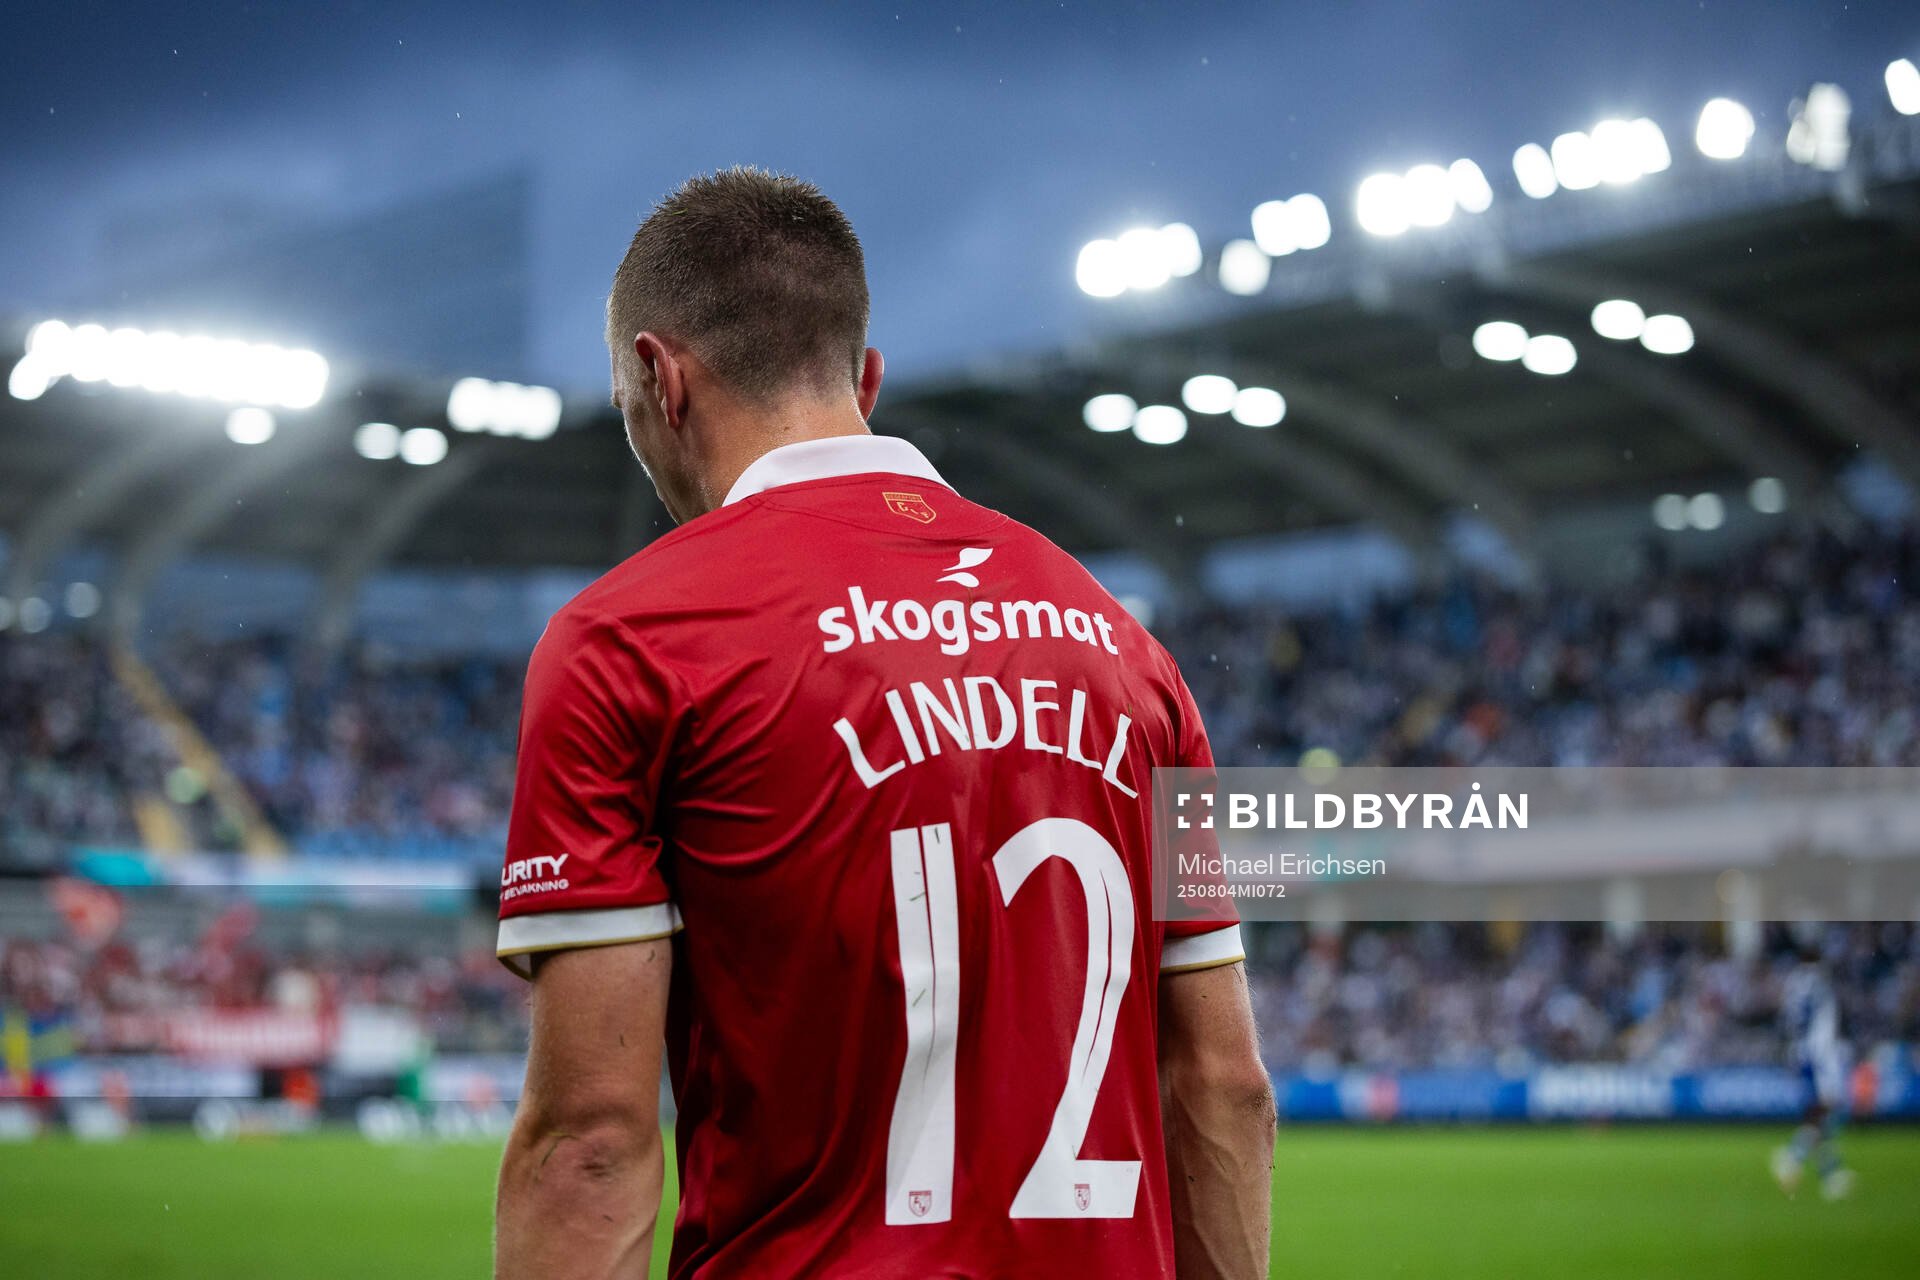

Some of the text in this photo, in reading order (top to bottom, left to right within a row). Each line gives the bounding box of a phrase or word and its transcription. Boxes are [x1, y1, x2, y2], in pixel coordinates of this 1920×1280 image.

[818, 586, 1118, 655] skogsmat
[833, 676, 1138, 799] LINDELL
[886, 817, 1142, 1226] 12
